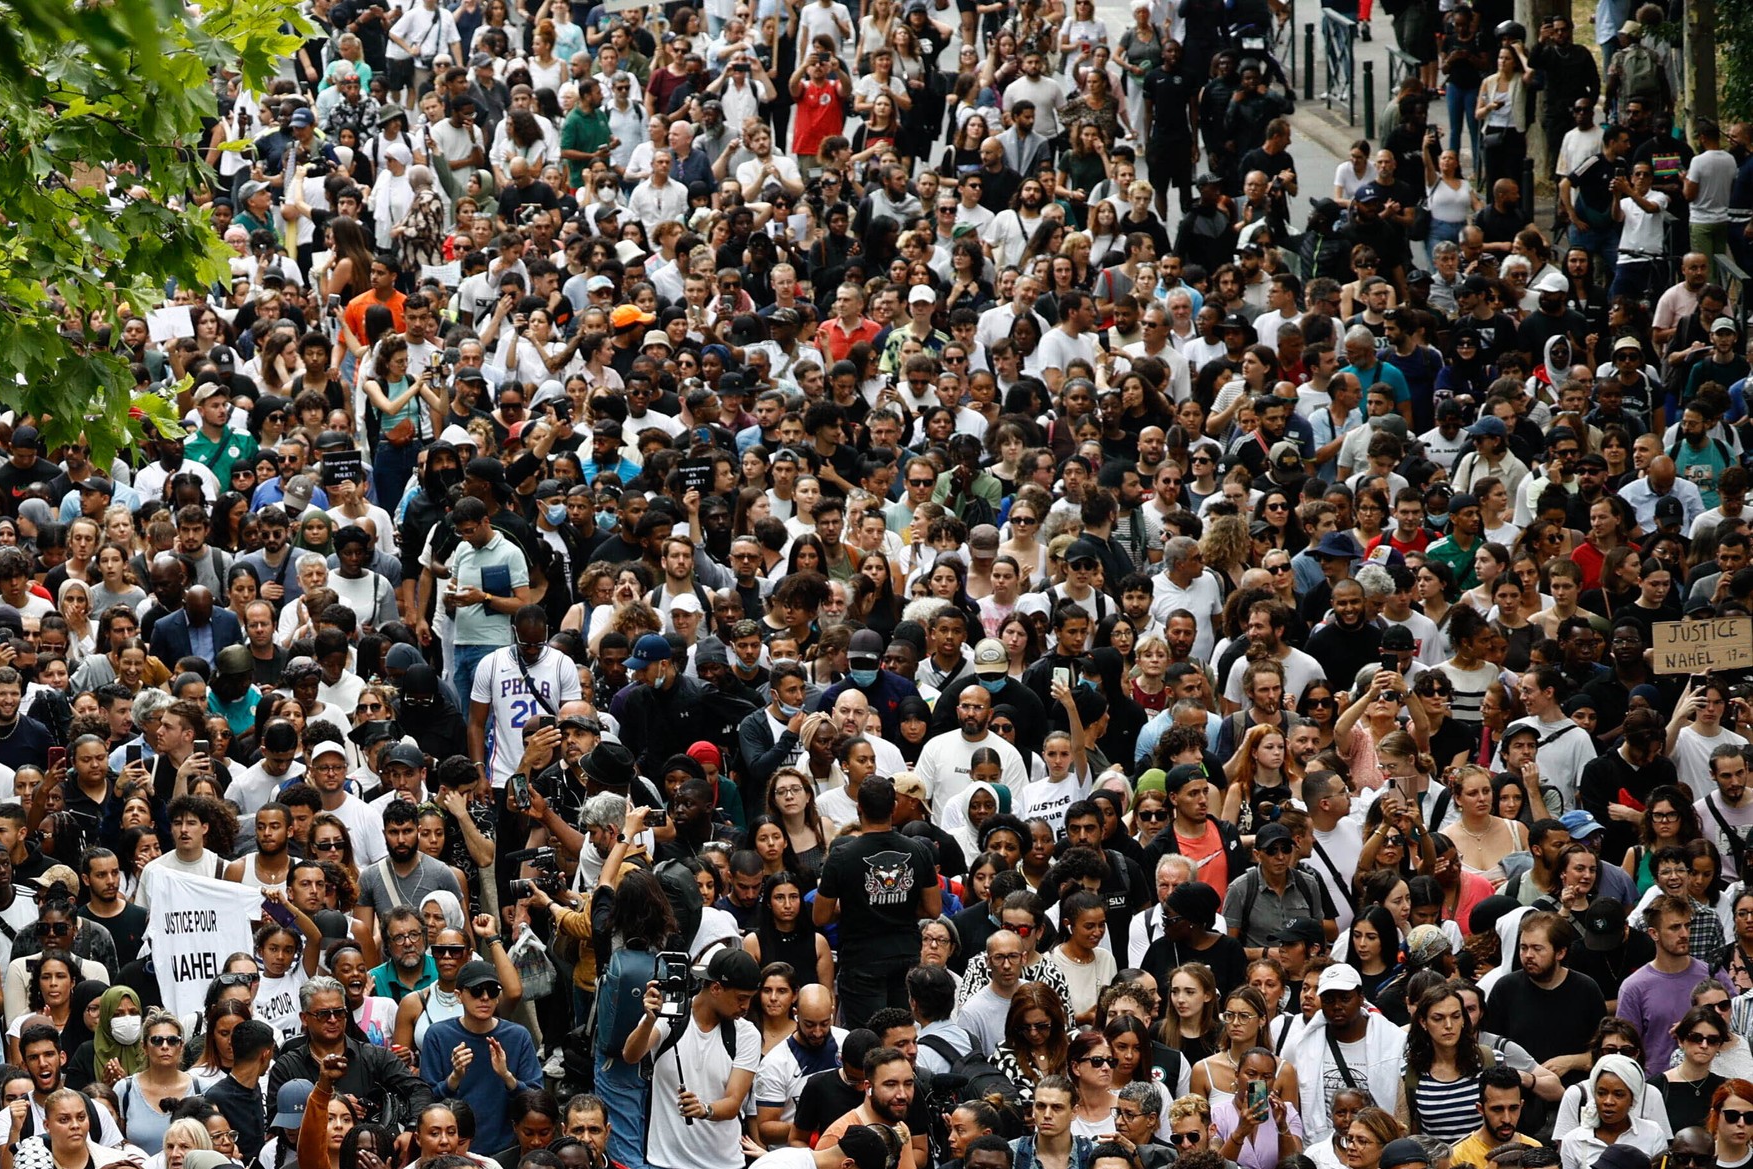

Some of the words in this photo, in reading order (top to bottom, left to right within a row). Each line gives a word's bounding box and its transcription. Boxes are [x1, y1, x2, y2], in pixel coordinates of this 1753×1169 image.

[501, 678, 551, 699] PHA
[1029, 795, 1071, 813] JUSTICE
[1040, 811, 1063, 821] OUR
[194, 910, 217, 932] POUR
[271, 992, 295, 1018] POUR
